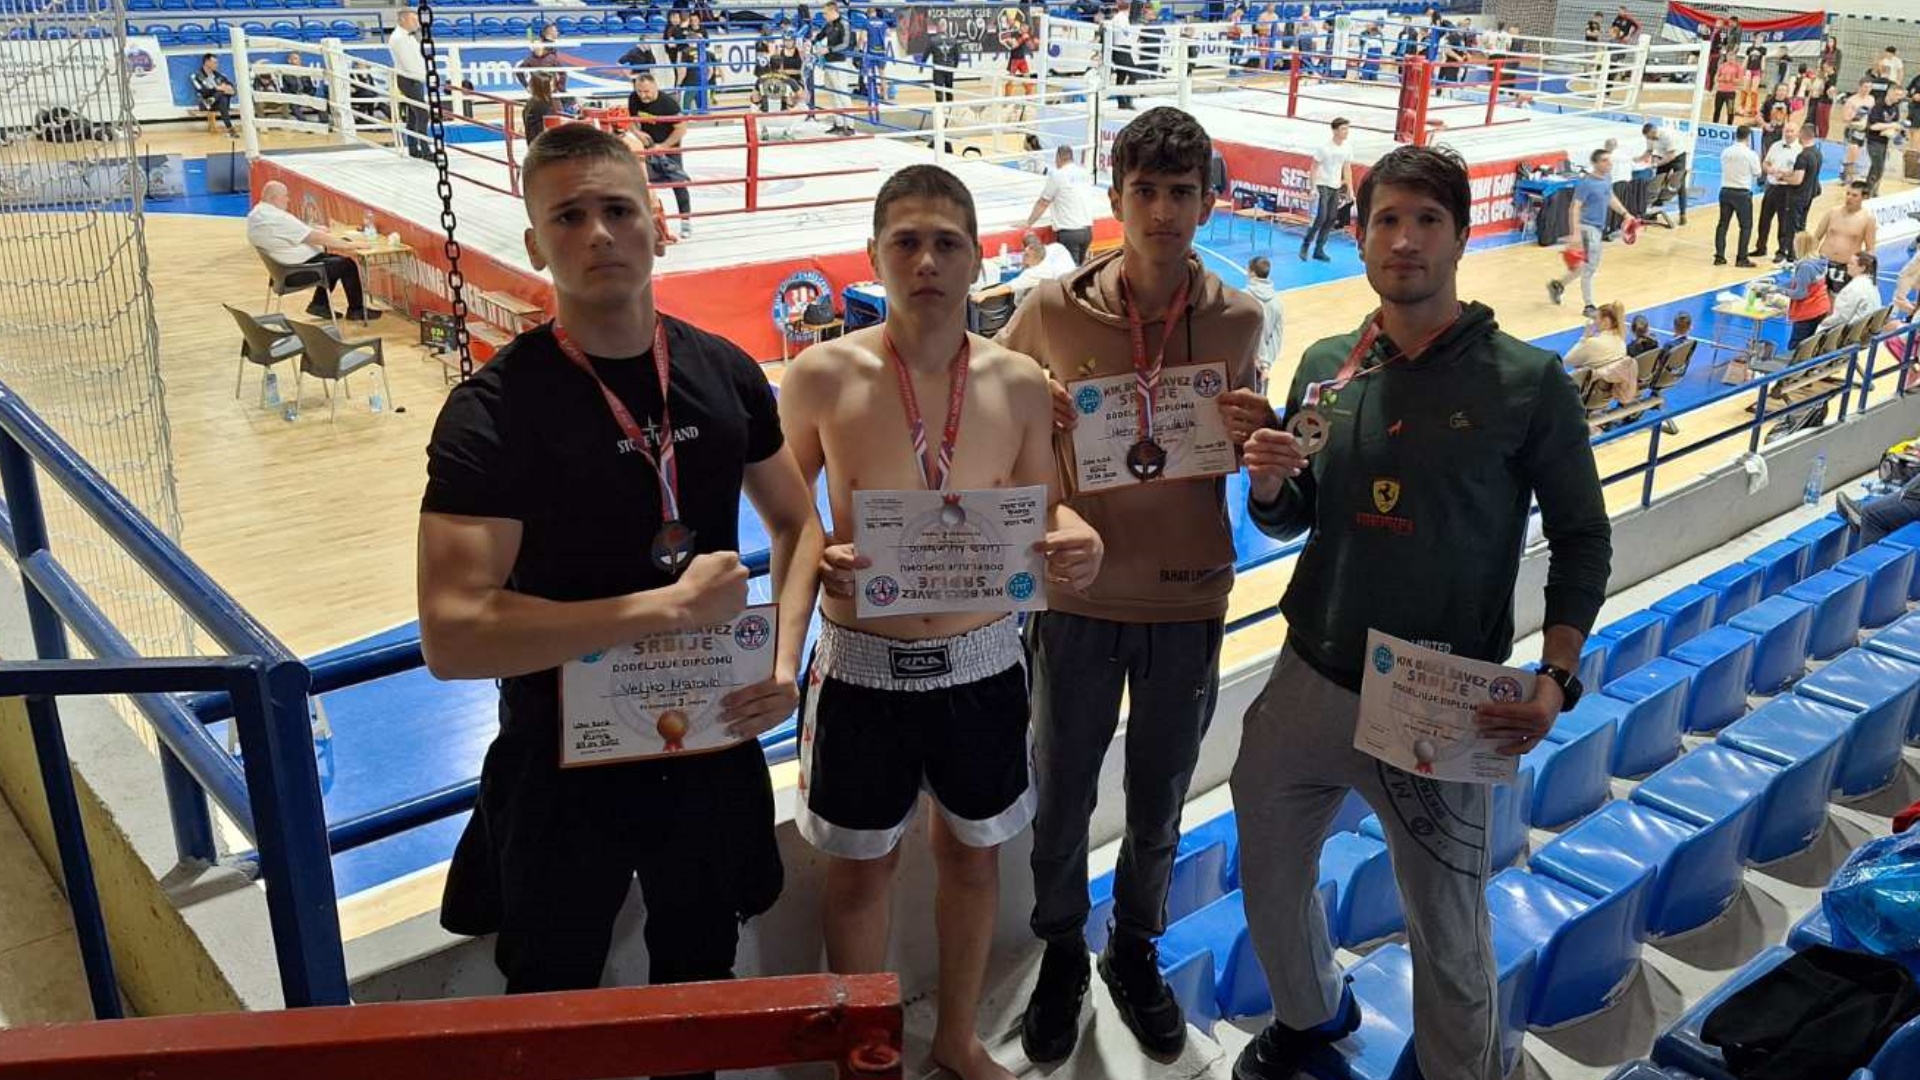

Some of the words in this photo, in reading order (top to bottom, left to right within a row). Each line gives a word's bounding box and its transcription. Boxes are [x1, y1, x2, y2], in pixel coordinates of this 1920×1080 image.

[617, 435, 651, 454] STOE
[655, 426, 699, 446] IAND
[901, 589, 941, 600] SAVEZ
[689, 624, 732, 637] AVEZ
[634, 636, 713, 655] SRBIJE
[1411, 639, 1452, 653] IMITED
[612, 659, 678, 673] DODELJUJE
[682, 655, 733, 667] DIPLOMU
[1440, 697, 1479, 712] DIPLOM
